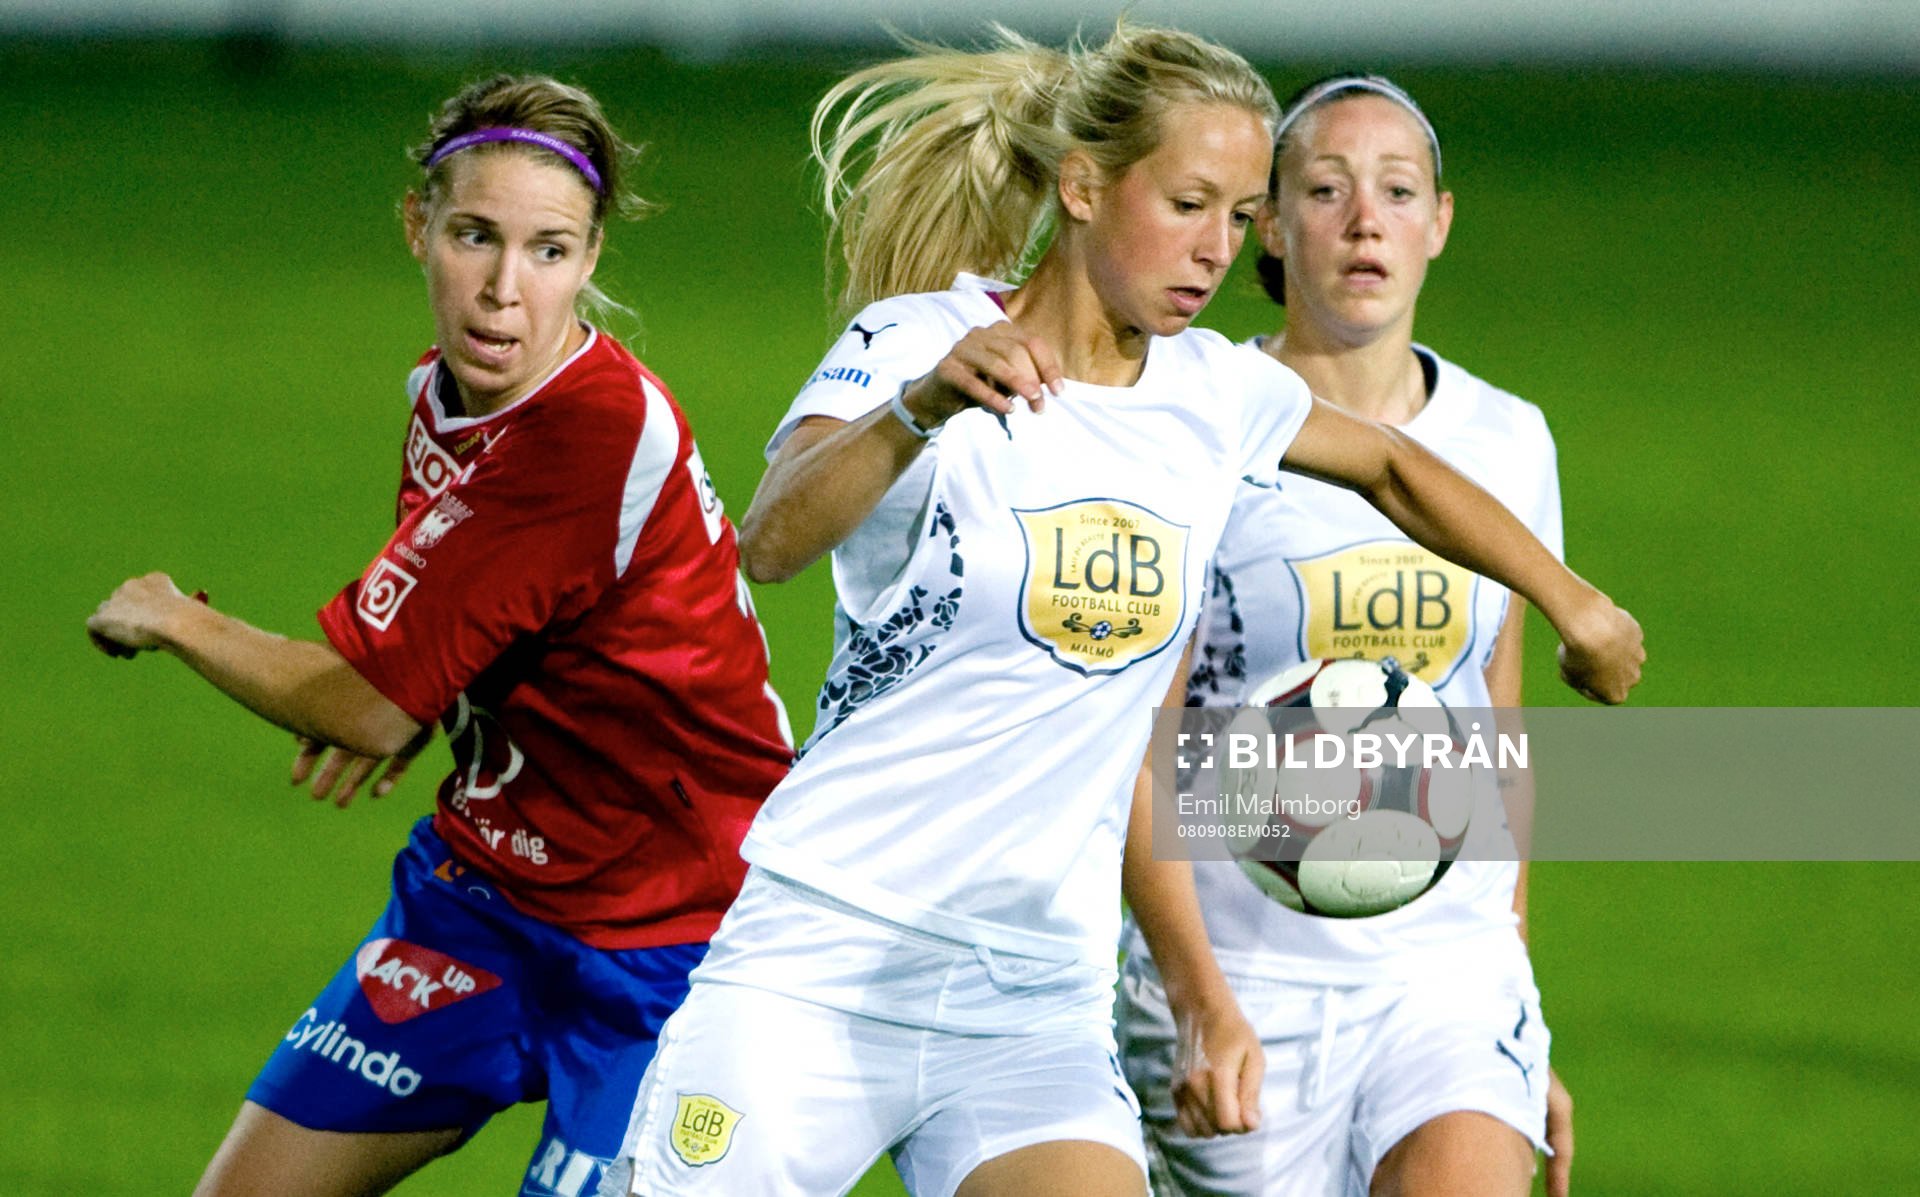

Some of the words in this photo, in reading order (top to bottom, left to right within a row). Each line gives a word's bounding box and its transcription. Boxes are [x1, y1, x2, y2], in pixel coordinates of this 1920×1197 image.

[1079, 514, 1109, 527] Since
[1112, 517, 1140, 529] 2007
[1052, 527, 1165, 598] LdB
[1051, 594, 1122, 612] FOOTBALL
[1127, 601, 1161, 616] CLUB
[1332, 570, 1452, 632] LdB
[1070, 643, 1115, 658] MALMÖ
[1333, 635, 1407, 649] FOOTBALL
[1413, 635, 1446, 648] CLUB
[511, 828, 549, 865] dig
[442, 964, 476, 995] UP
[285, 1007, 423, 1097] Cylinda
[681, 1102, 725, 1137] LdB
